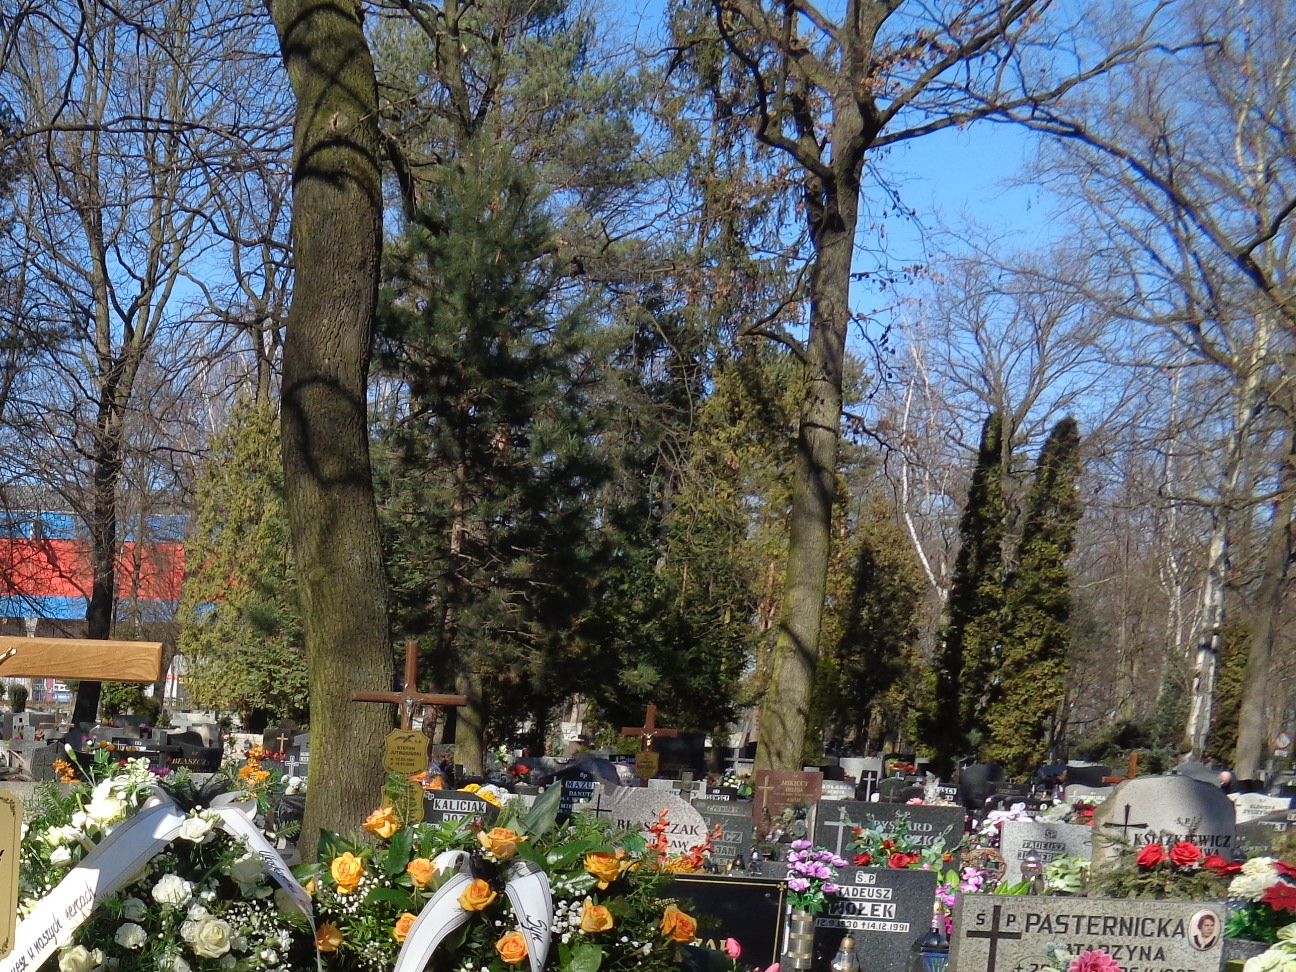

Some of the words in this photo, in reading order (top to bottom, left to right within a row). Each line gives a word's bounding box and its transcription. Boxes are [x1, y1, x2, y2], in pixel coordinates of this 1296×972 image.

[434, 799, 486, 813] KALICIAK
[838, 886, 891, 899] TADEUSZ
[866, 922, 908, 932] 14.12.1991
[976, 910, 986, 926] Ś
[1006, 914, 1015, 927] P
[1024, 913, 1186, 938] PASTERNICKA
[1064, 943, 1166, 961] ATARZYNA
